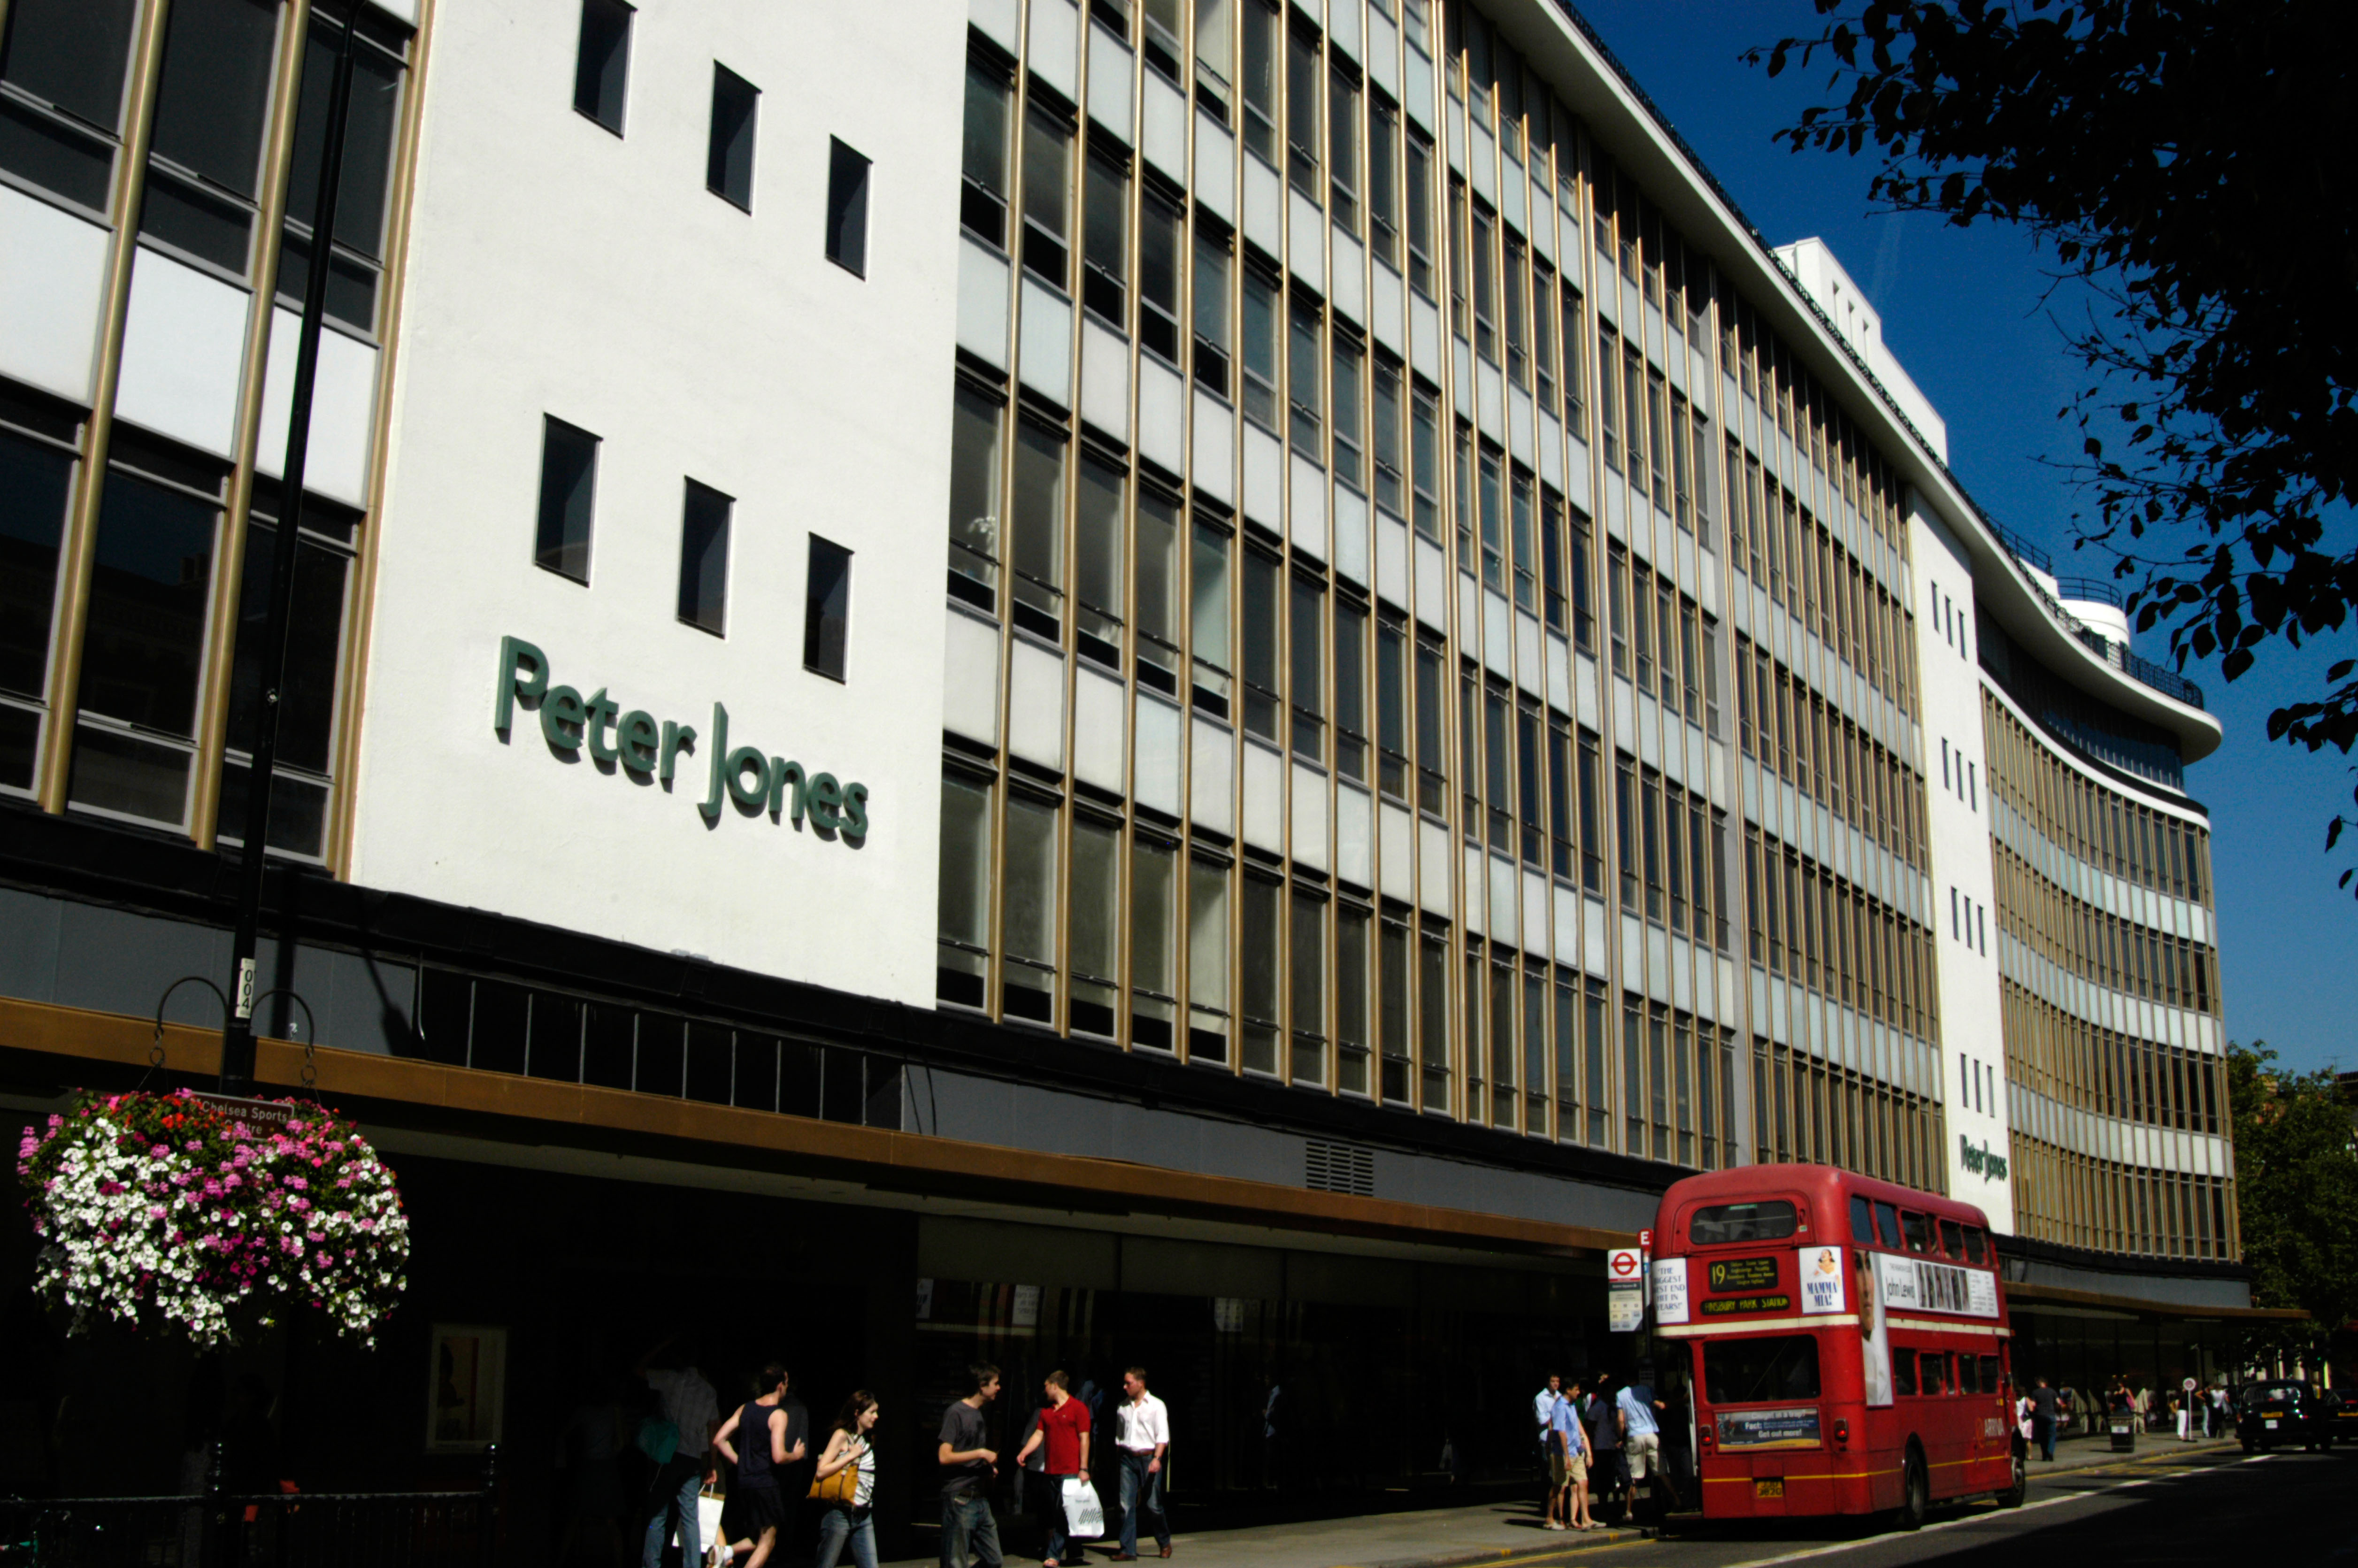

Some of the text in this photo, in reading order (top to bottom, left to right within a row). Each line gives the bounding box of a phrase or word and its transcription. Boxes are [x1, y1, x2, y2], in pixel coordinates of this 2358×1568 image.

[494, 635, 869, 838] Peter Jones
[242, 969, 253, 1009] 004
[202, 1100, 288, 1122] Chelsea Sports
[1959, 1134, 2007, 1182] Peter Jones
[1640, 1231, 1650, 1245] E
[1651, 1275, 1682, 1284] IGGEST
[1713, 1264, 1726, 1285] 19
[1670, 1284, 1685, 1292] END
[1807, 1282, 1837, 1294] MAMMA
[1885, 1275, 1899, 1301] John
[1705, 1300, 1736, 1312] FINSBURY
[1739, 1298, 1758, 1310] PARK
[1814, 1295, 1833, 1307] MIA!
